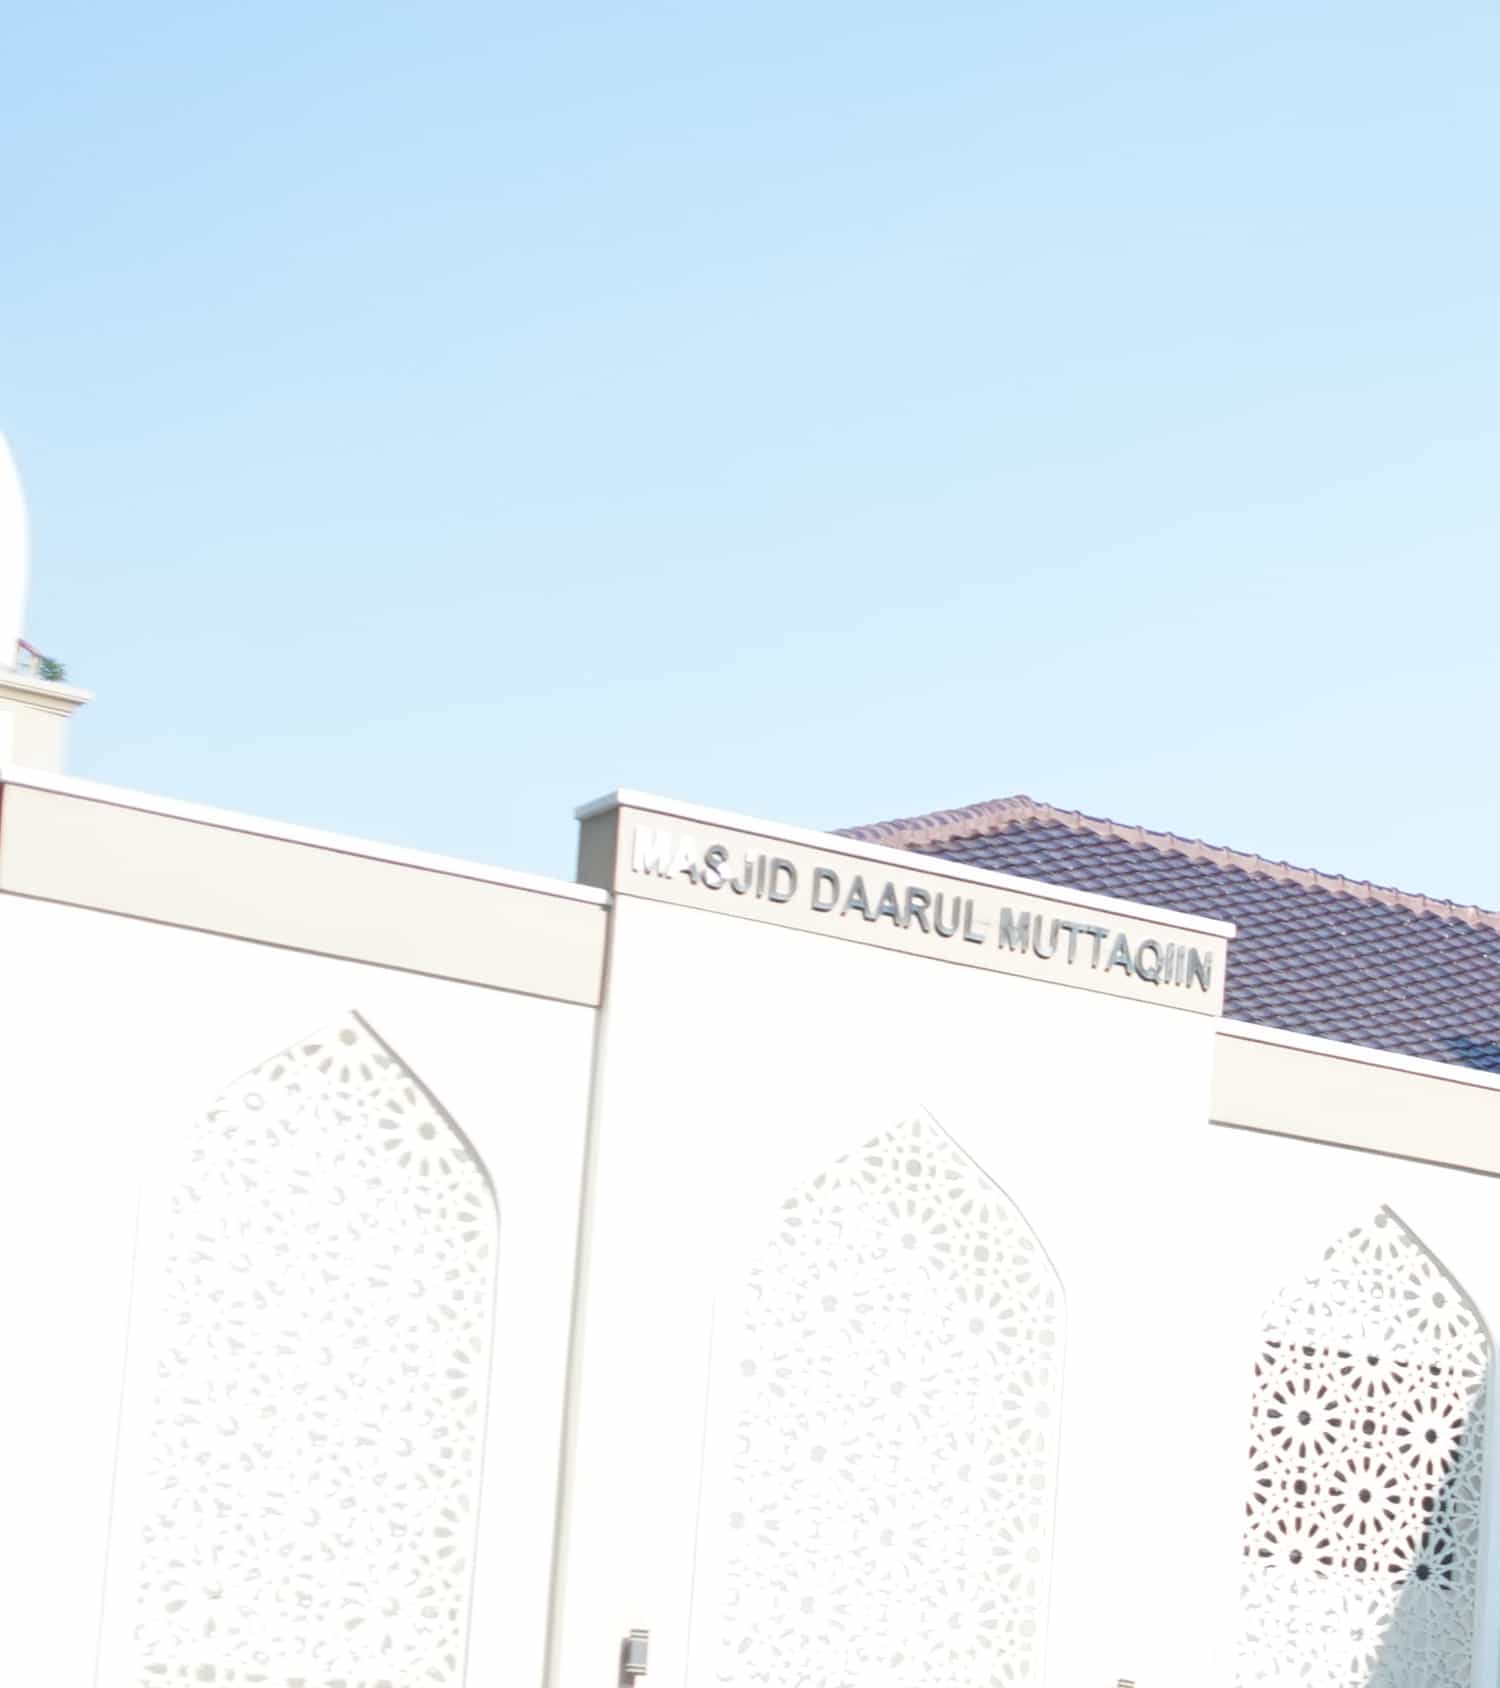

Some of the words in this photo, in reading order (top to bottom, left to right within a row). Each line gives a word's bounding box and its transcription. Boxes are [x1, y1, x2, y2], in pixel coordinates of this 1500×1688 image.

[630, 823, 798, 904] MASJID
[811, 866, 986, 946] DAARUL
[998, 906, 1213, 993] MUTTAQIIN
